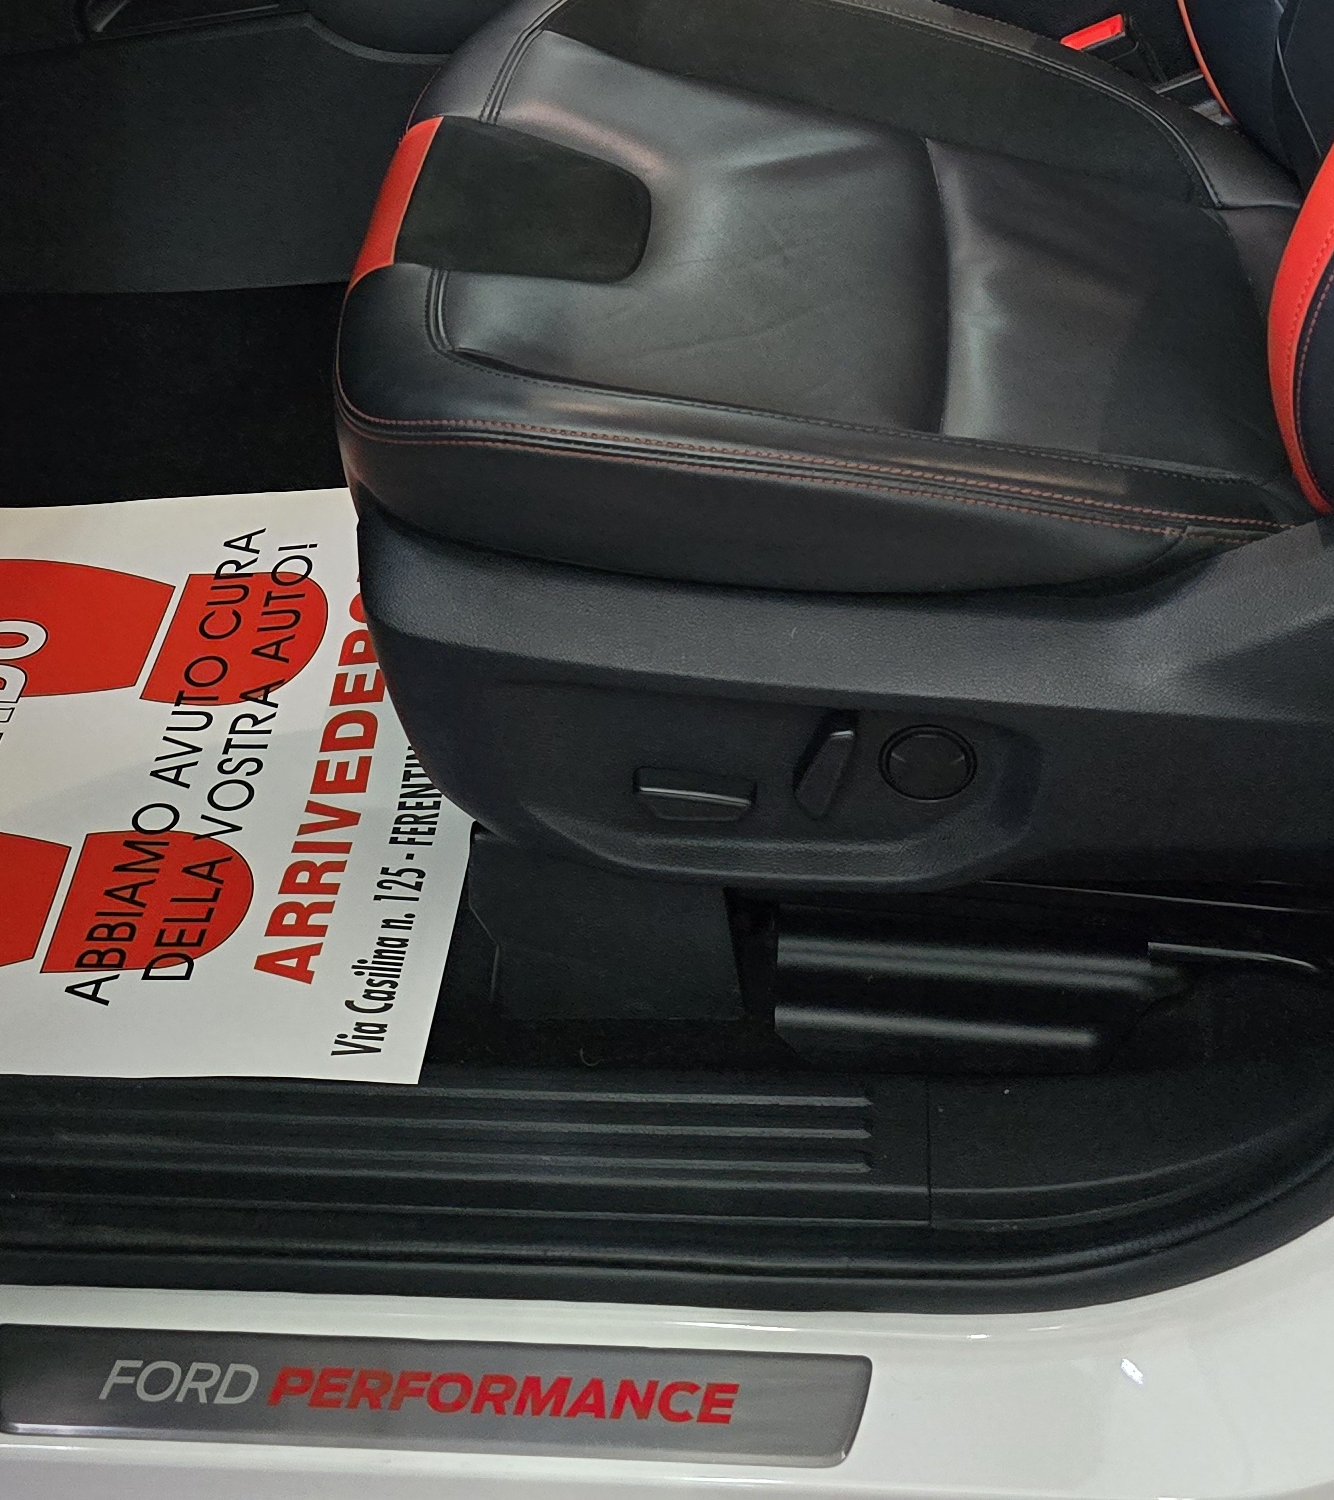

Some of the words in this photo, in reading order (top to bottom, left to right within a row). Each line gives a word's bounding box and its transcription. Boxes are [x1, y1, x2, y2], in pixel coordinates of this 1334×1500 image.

[64, 802, 180, 1007] ABBIAMO
[149, 654, 229, 789] AVUTO
[198, 527, 267, 640] CURA
[140, 855, 234, 981] DELLA
[192, 678, 286, 841] VOSTRA
[250, 542, 319, 664] AUTO!
[388, 746, 443, 846] FERENT
[372, 866, 427, 902] 125
[380, 912, 416, 931] n.
[344, 936, 410, 1014] Casilina
[330, 1021, 389, 1056] Via
[98, 1359, 260, 1405] FORD
[267, 1365, 740, 1425] PERFORMANCE
